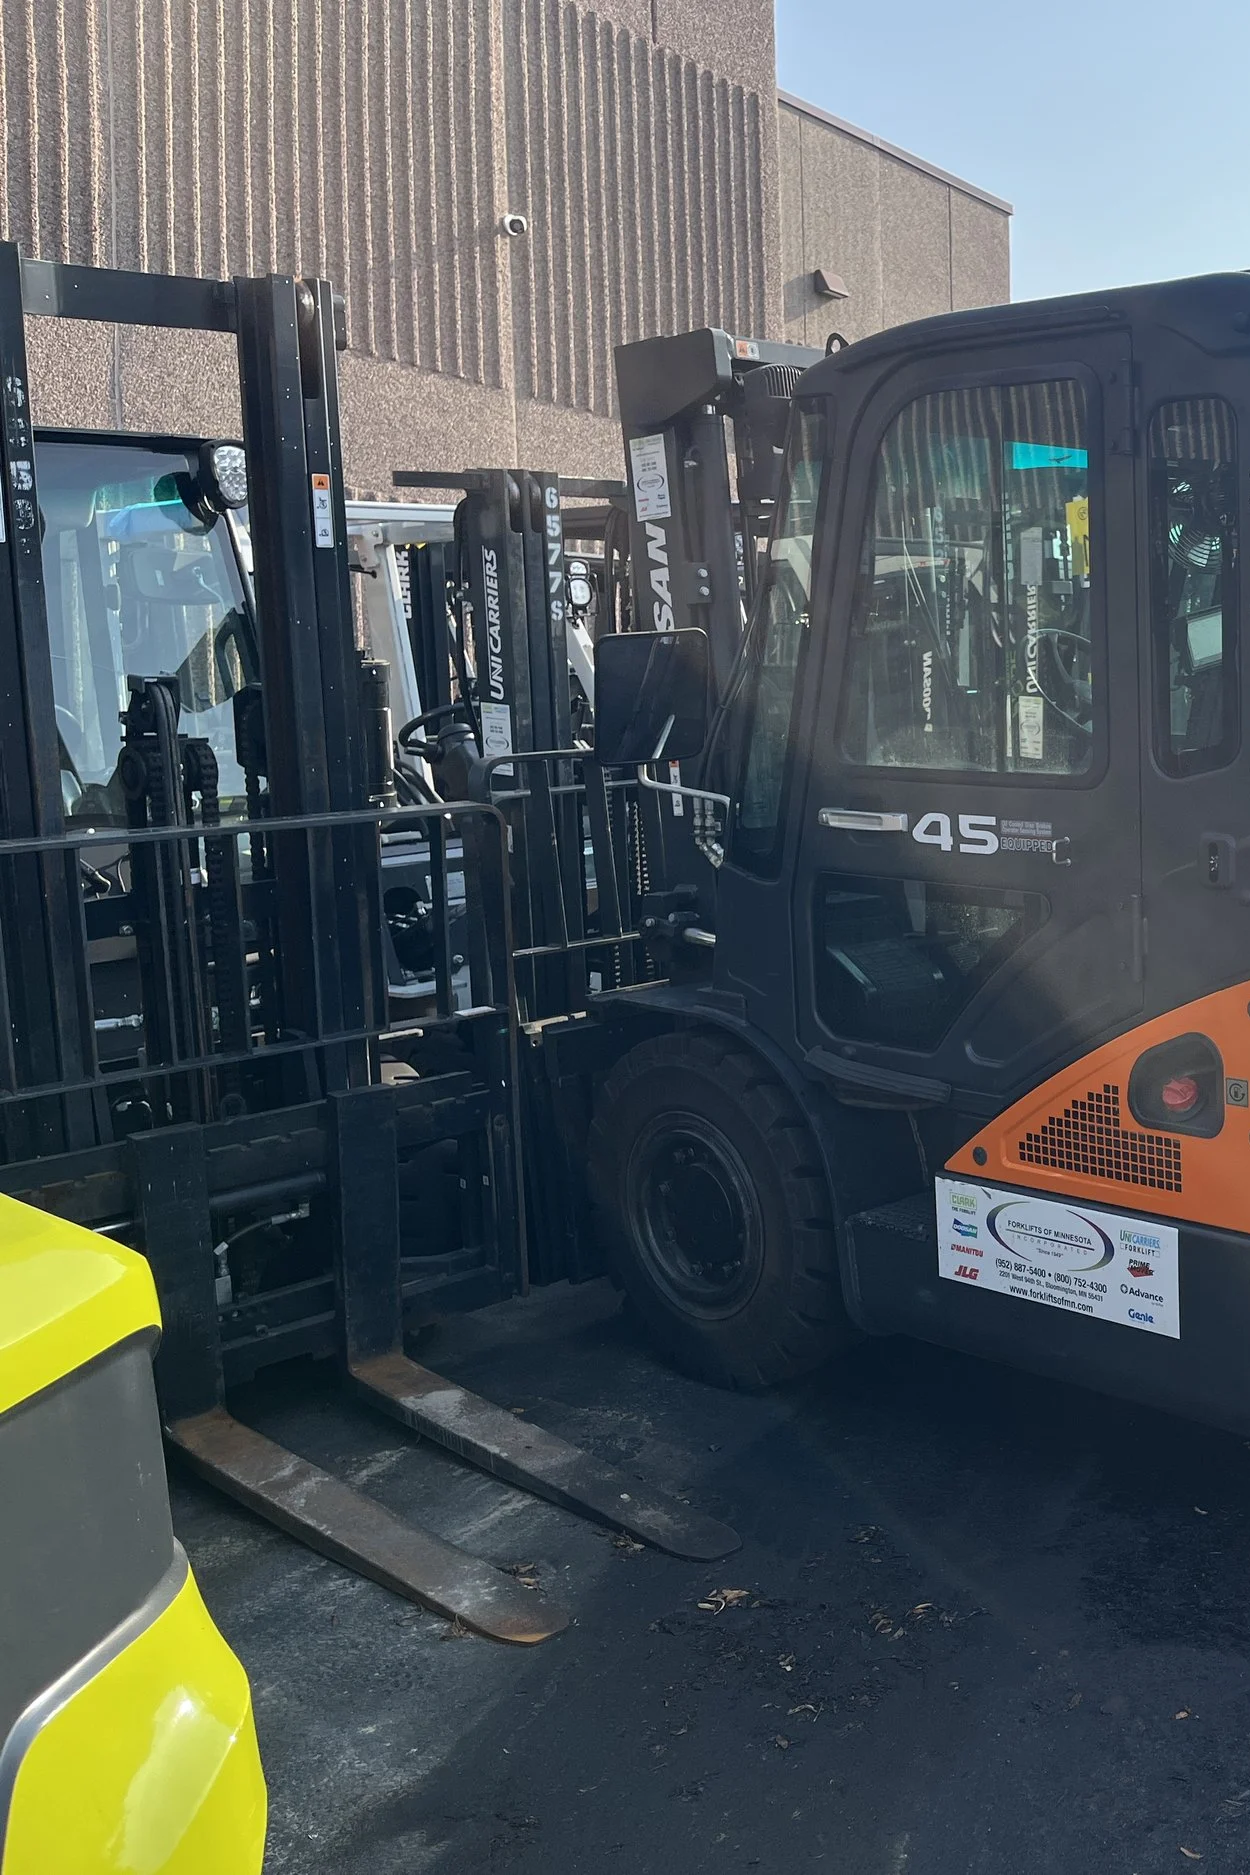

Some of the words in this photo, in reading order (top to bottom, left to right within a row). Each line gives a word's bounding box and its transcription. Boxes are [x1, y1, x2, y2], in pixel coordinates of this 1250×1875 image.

[545, 486, 563, 621] 6577S
[482, 546, 505, 701] UNICARRIERS
[912, 812, 999, 855] 45
[1001, 837, 1053, 853] EQUIPPED
[951, 1194, 976, 1209] CLARK
[1007, 1220, 1042, 1234] FORKLIFTS
[1044, 1228, 1053, 1236] OF
[1054, 1231, 1092, 1245] MINNESOTA
[955, 1245, 984, 1257] MANITOU
[1012, 1235, 1089, 1255] INCORPORATED
[1124, 1244, 1156, 1257] FORKLIFT
[1129, 1258, 1150, 1268] PRIME
[954, 1265, 979, 1280] JLG
[995, 1258, 1012, 1271] (952)
[1014, 1262, 1046, 1278] 887-5400
[1054, 1272, 1072, 1286] (800)
[1074, 1277, 1107, 1294] 752-4300
[1011, 1272, 1024, 1281] West
[1009, 1284, 1094, 1313] www.forkliftsofmn.com
[1129, 1287, 1164, 1302] Advance
[1128, 1308, 1154, 1323] Genie
